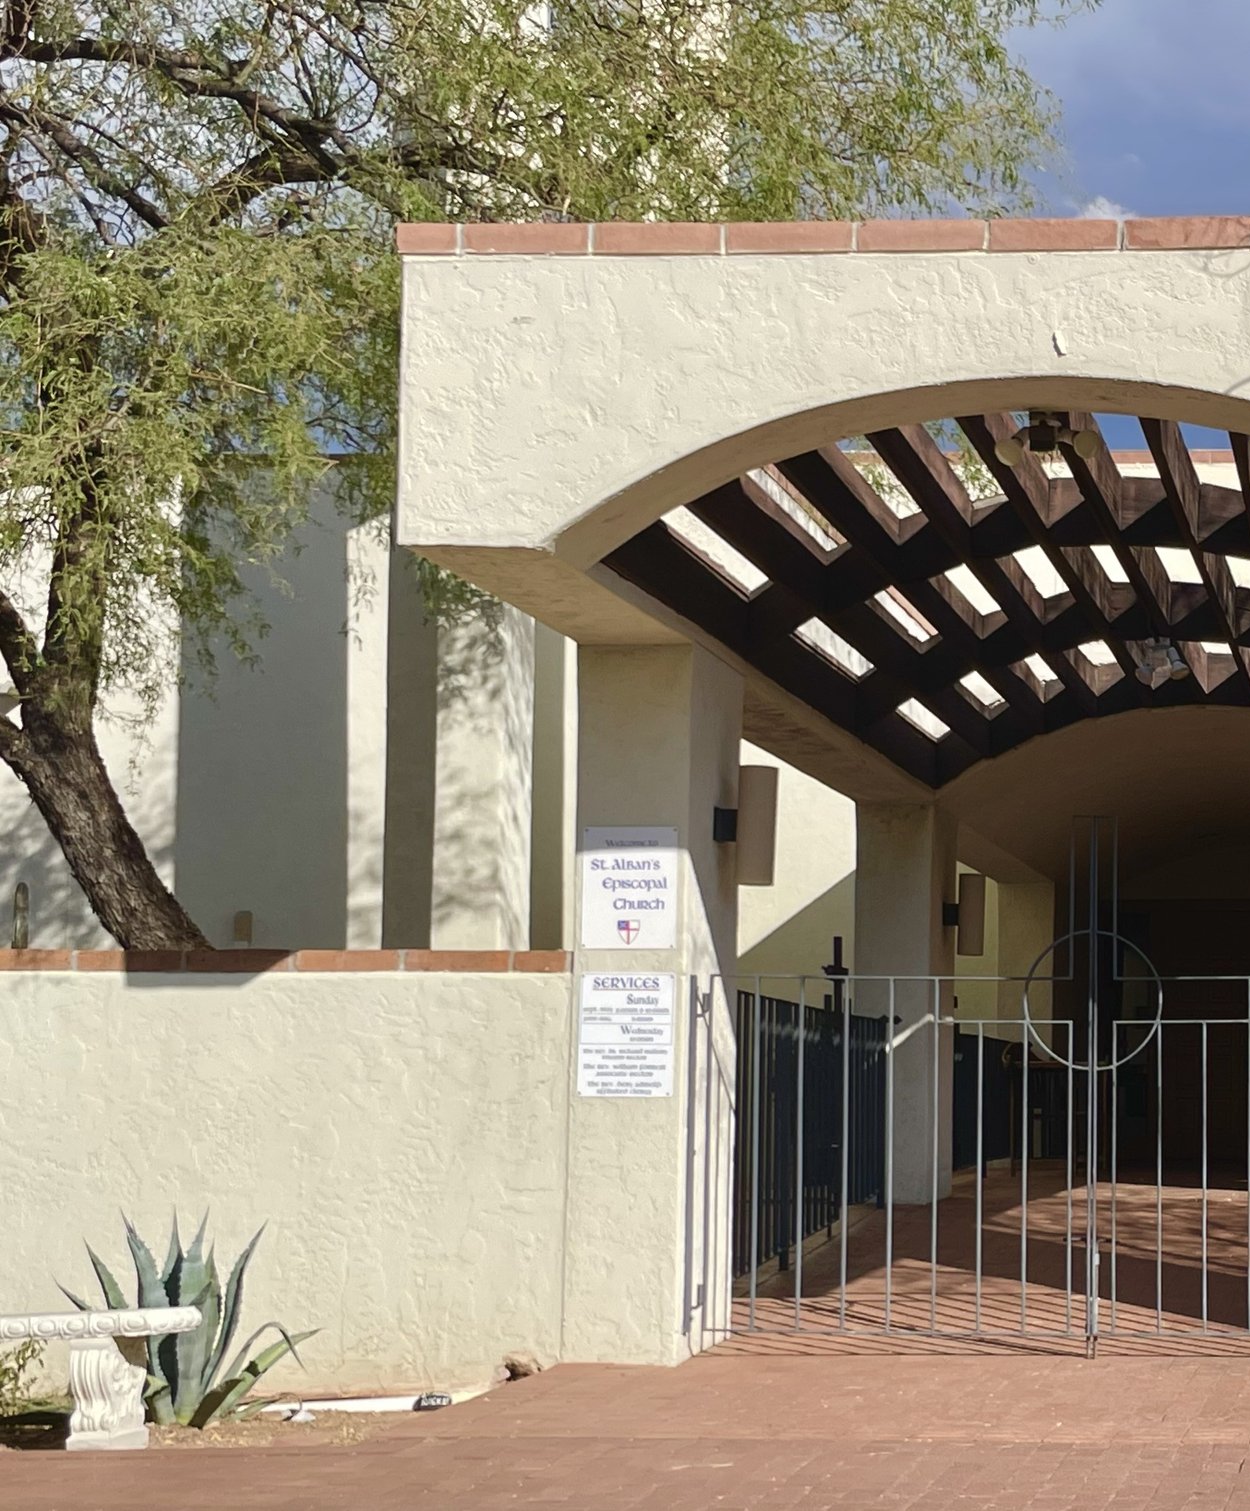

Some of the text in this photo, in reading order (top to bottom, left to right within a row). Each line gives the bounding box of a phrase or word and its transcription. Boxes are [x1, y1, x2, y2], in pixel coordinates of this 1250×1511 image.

[602, 877, 668, 892] Episcopal
[613, 898, 665, 910] Church
[593, 976, 660, 989] SERVICES
[626, 993, 659, 1006] Sunday
